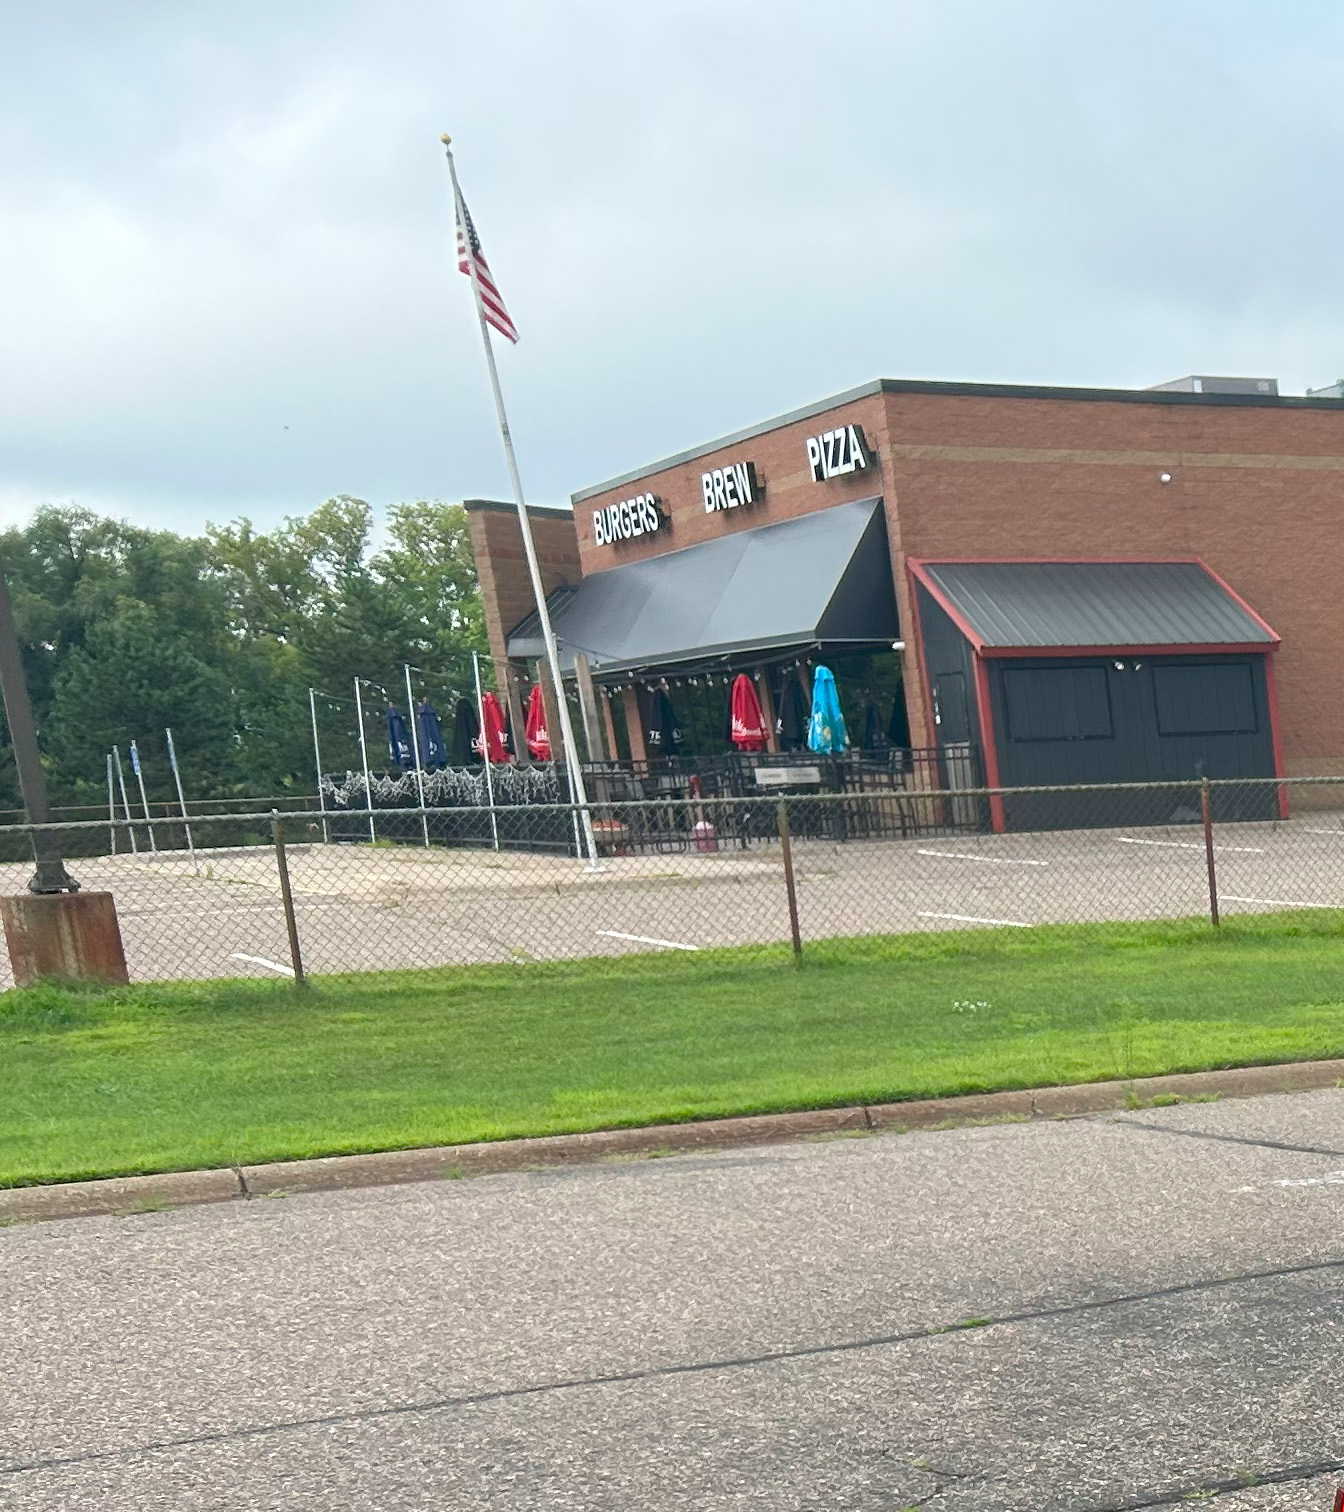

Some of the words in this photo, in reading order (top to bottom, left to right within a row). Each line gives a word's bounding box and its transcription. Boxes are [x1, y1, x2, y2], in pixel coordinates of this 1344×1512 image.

[593, 493, 658, 546] BURGERS
[702, 462, 754, 513] BREW
[807, 425, 866, 481] PIZZA
